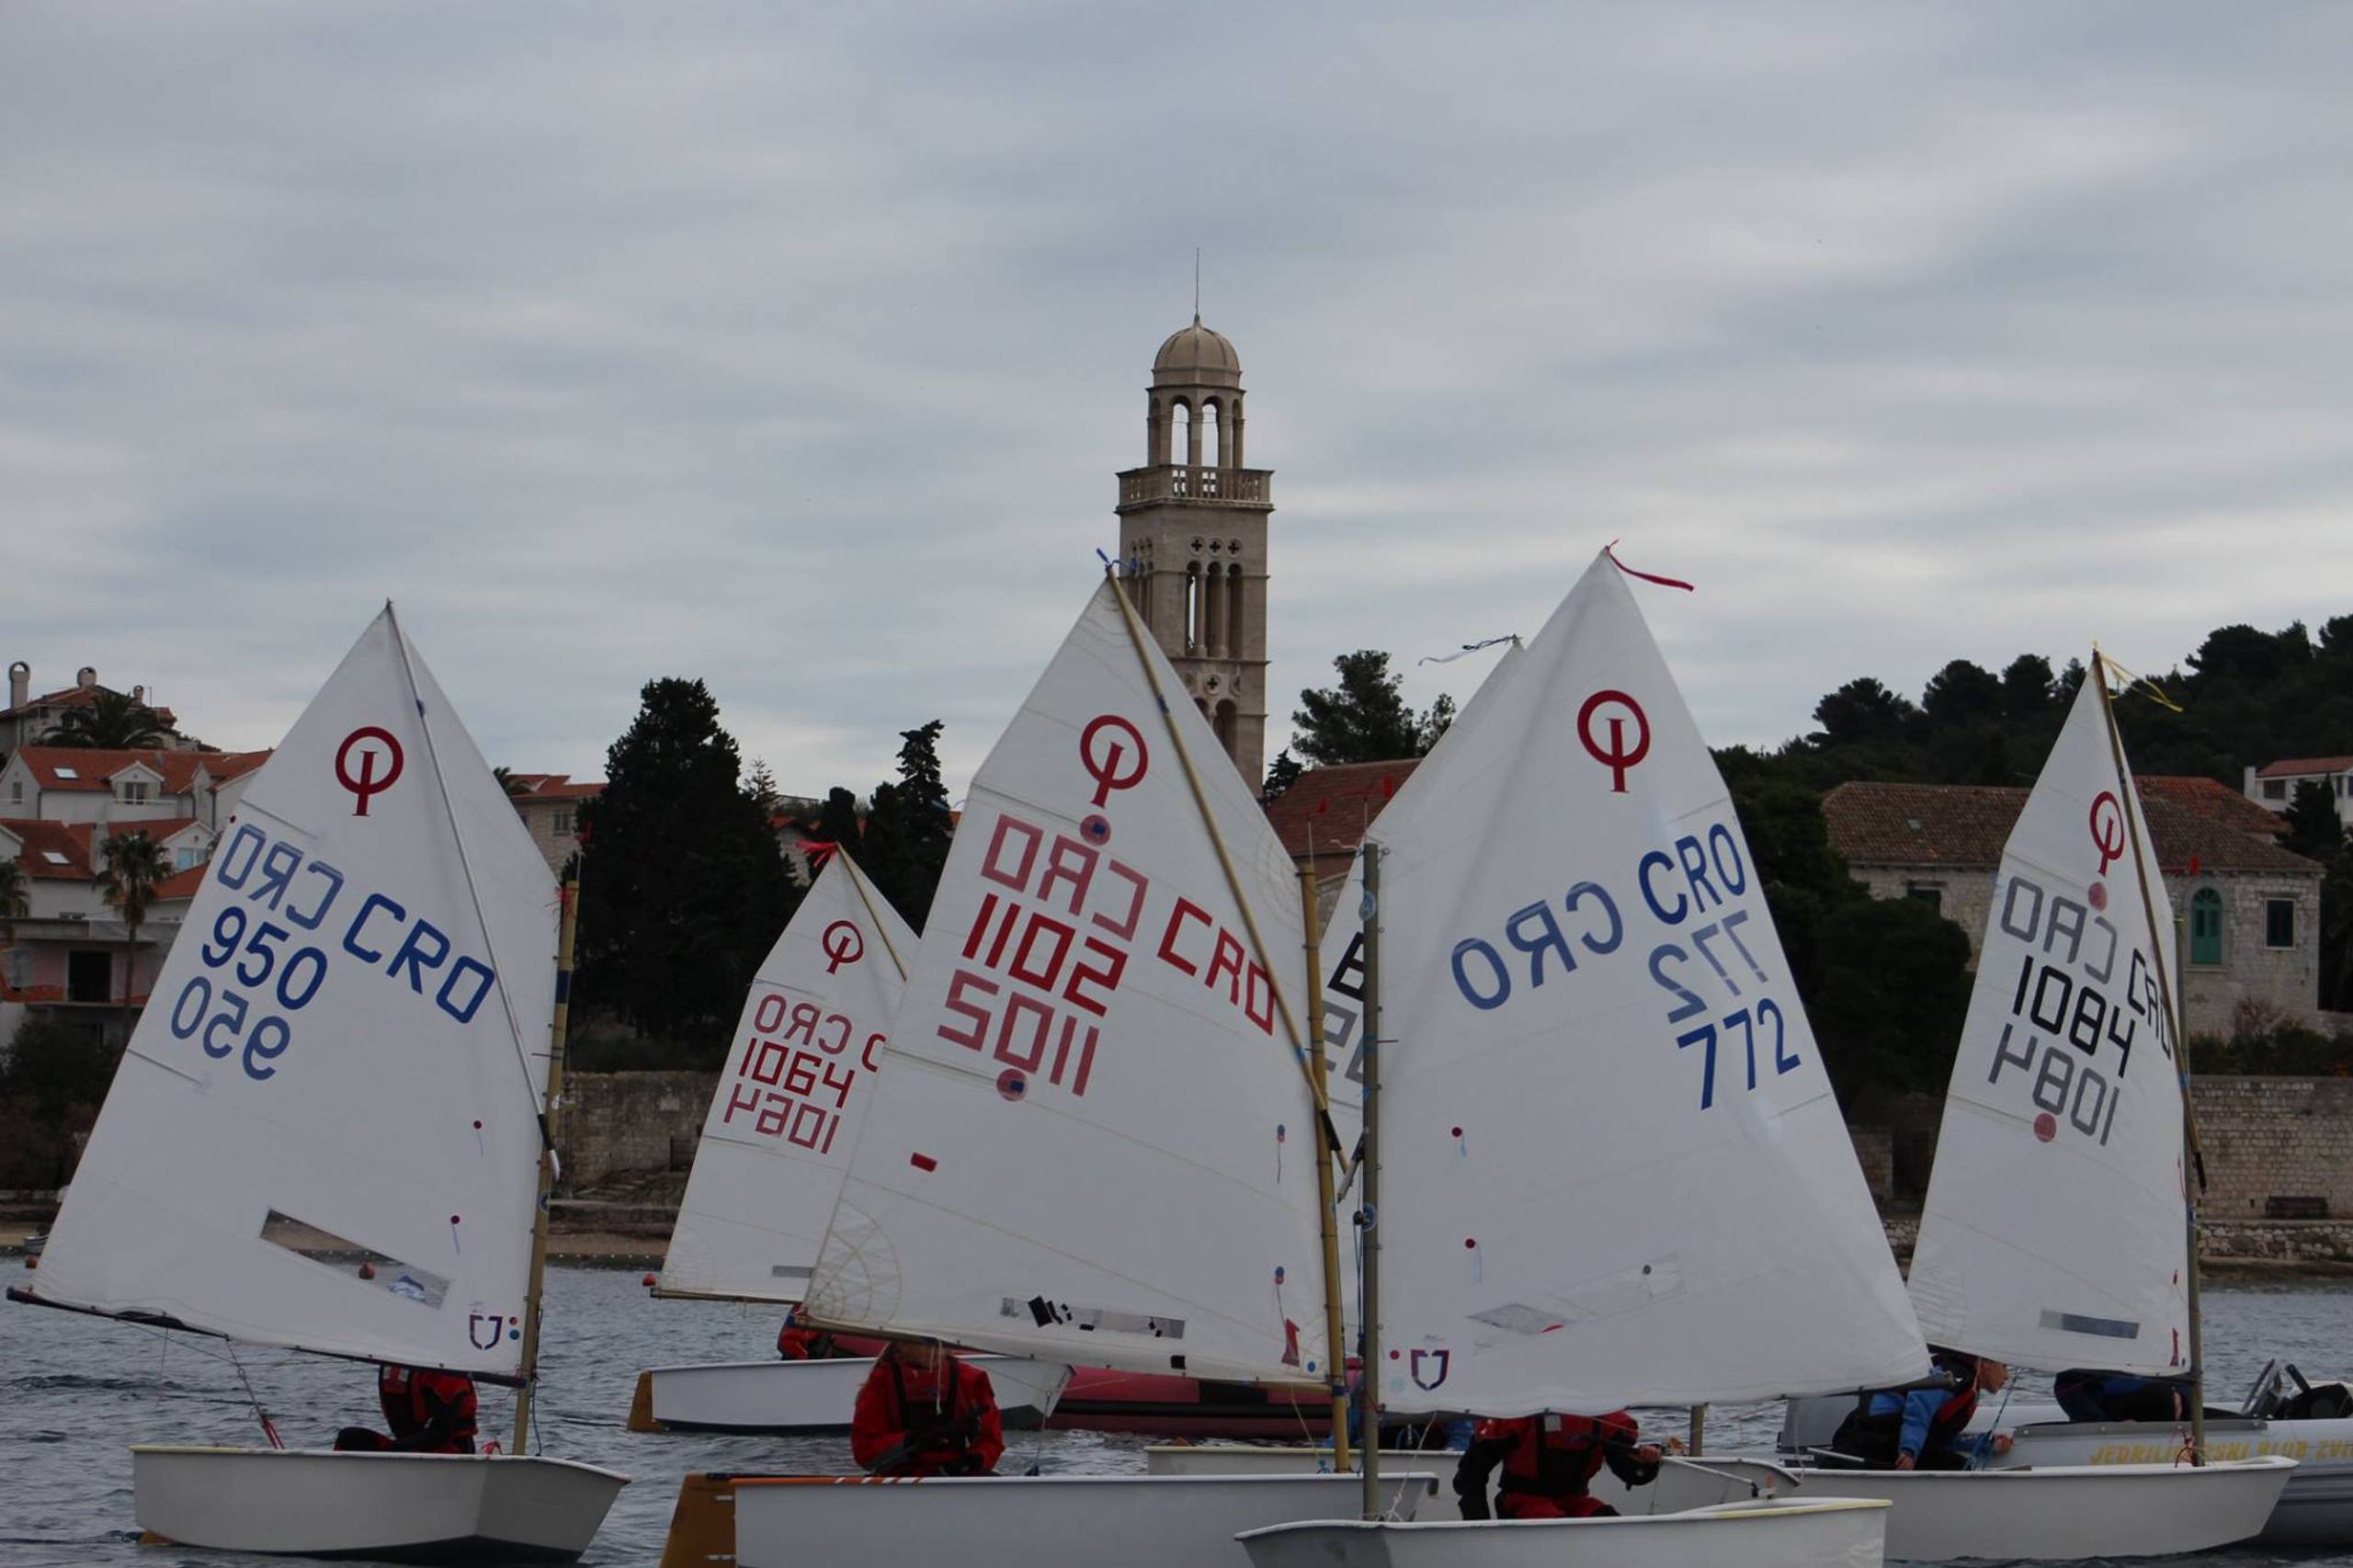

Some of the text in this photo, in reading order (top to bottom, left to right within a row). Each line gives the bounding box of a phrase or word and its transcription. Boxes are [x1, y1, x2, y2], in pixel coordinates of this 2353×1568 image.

[1638, 824, 1746, 925] CRO
[202, 906, 327, 1010] 950
[343, 892, 495, 1024] CRO
[961, 892, 1128, 1017] 1102
[1157, 896, 1277, 1036] CRO
[739, 1038, 855, 1108] 1064
[1677, 997, 1802, 1110] 772
[2012, 955, 2135, 1078] 1084
